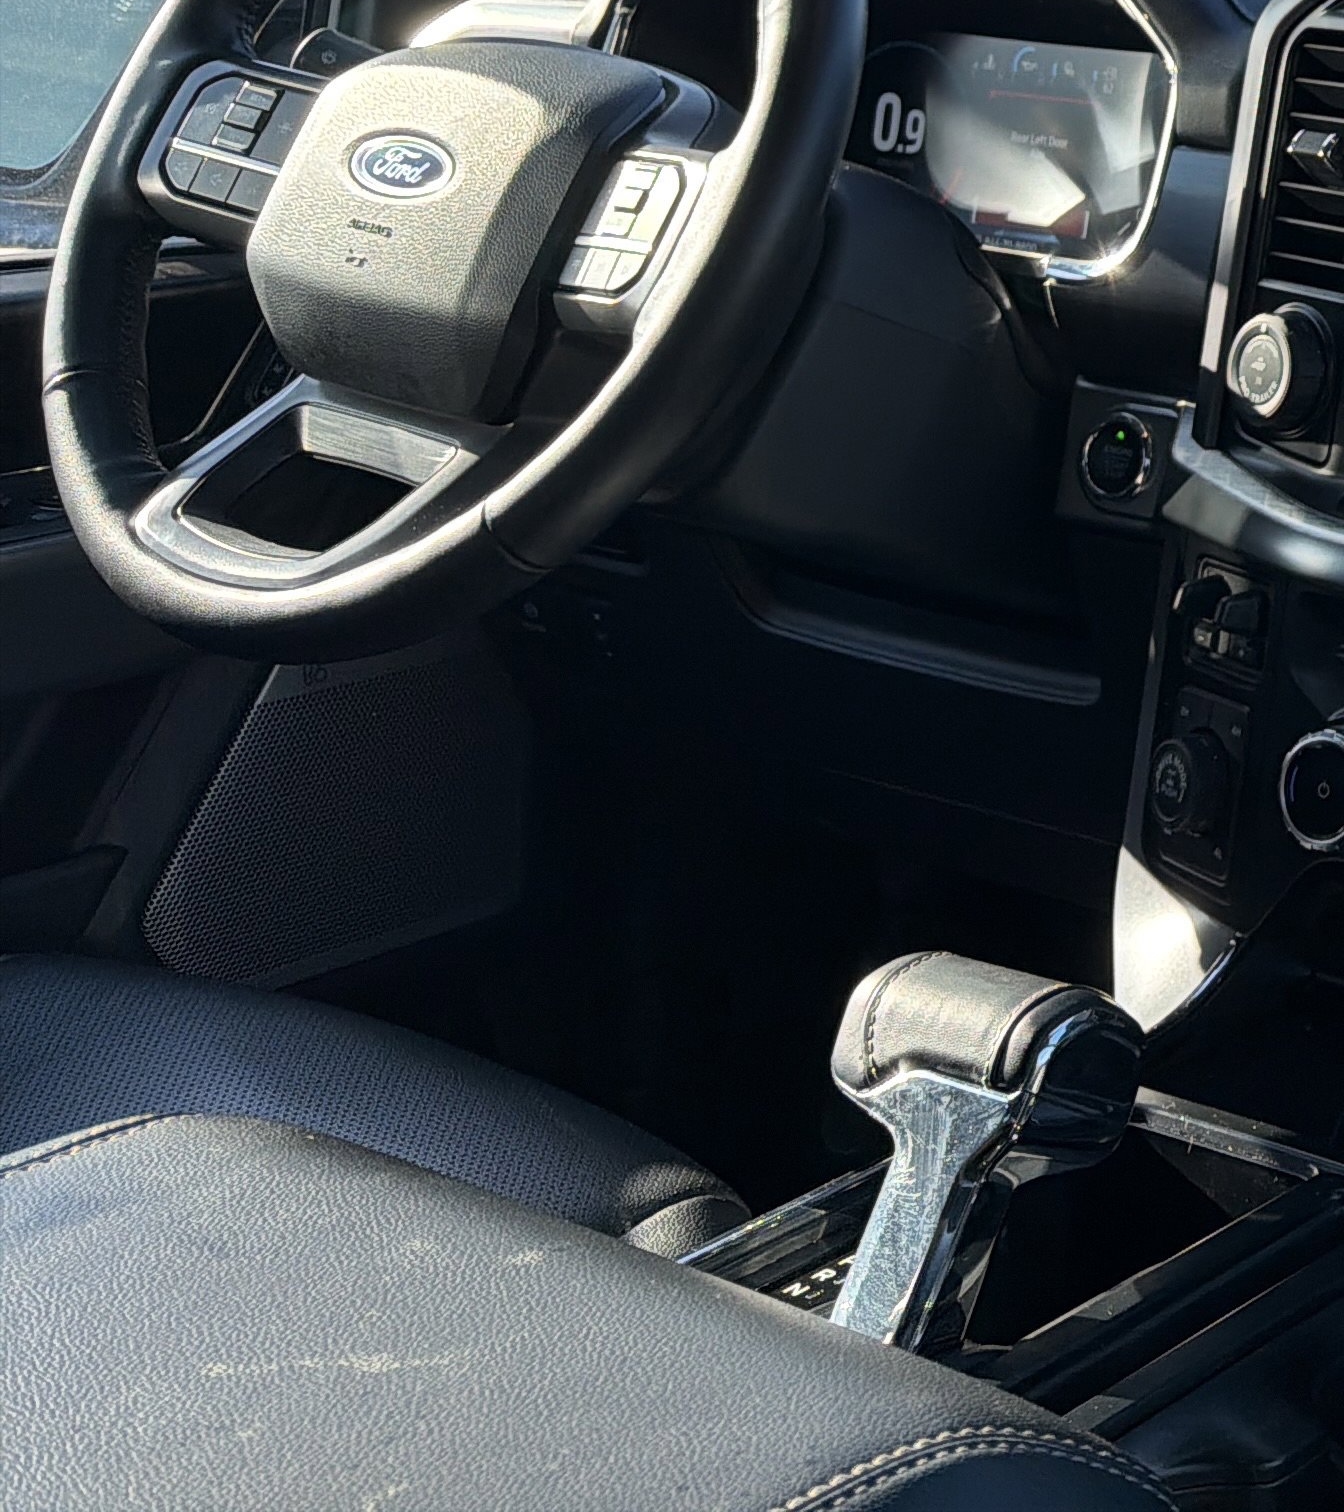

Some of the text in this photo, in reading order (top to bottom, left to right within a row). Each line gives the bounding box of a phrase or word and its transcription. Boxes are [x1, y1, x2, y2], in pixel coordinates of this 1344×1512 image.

[872, 91, 926, 155] 0.9
[371, 144, 426, 186] Ford
[810, 1268, 837, 1282] R
[781, 1282, 811, 1297] N
